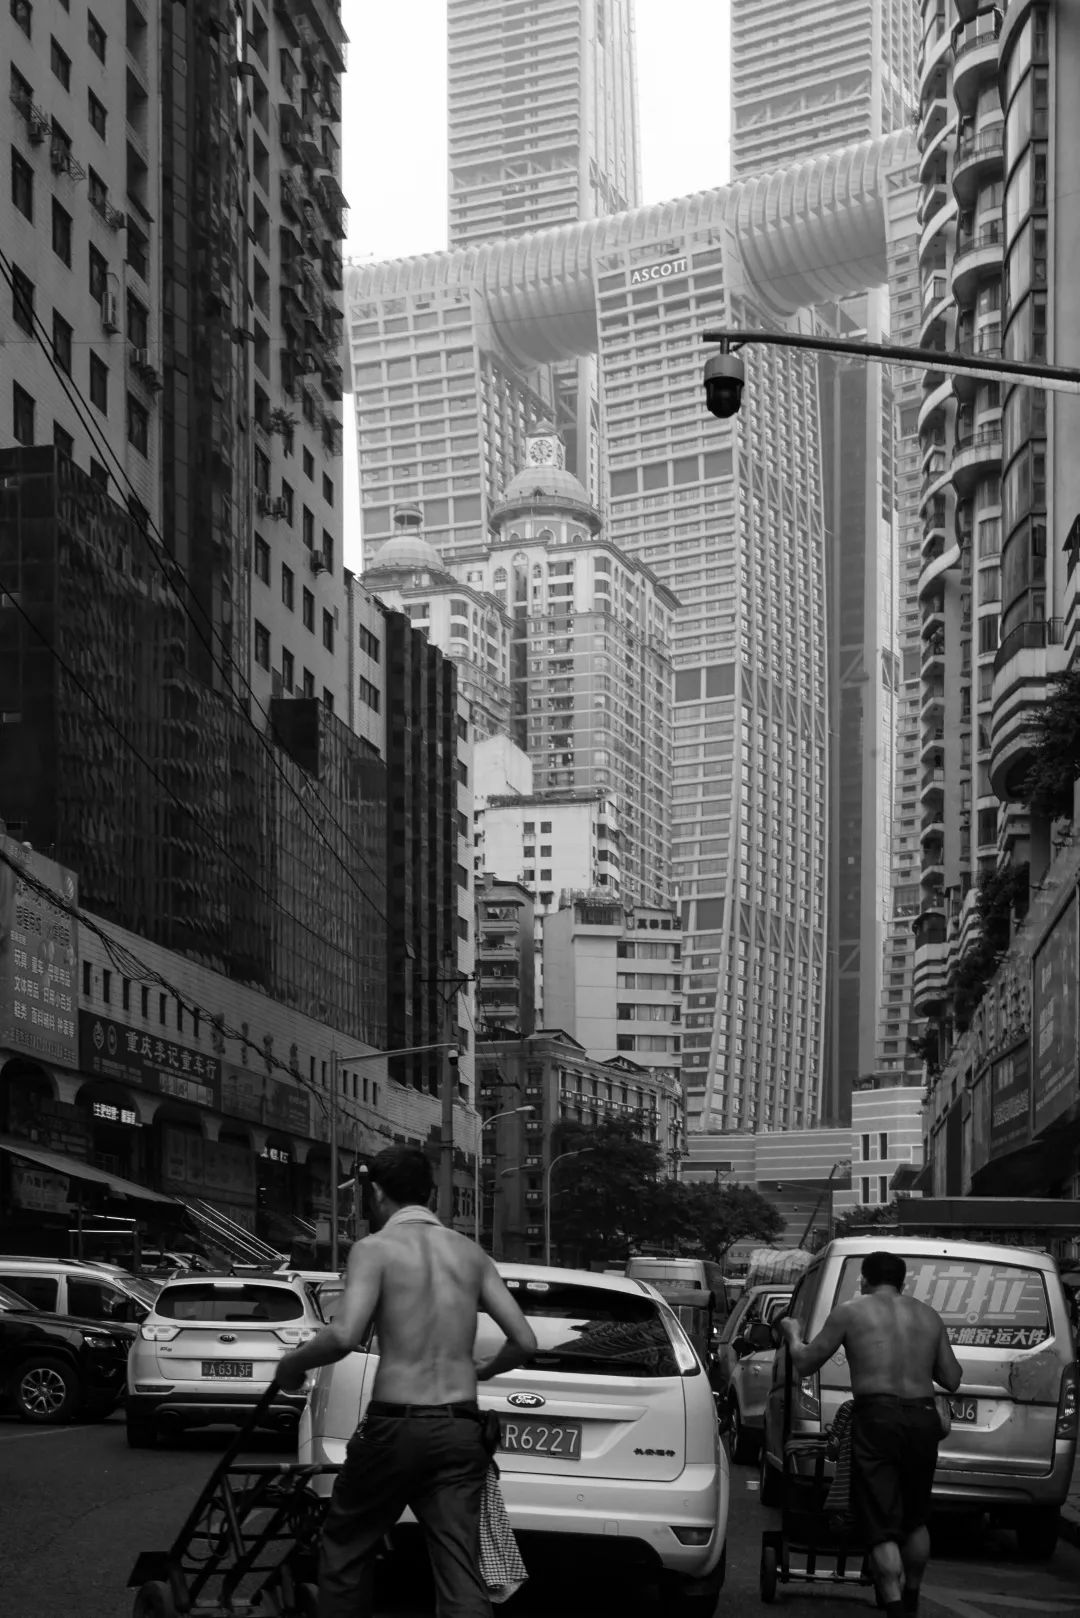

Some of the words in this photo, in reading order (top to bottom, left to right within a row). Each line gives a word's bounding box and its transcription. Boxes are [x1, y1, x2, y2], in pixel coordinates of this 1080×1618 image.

[632, 259, 687, 284] ASCOTT
[14, 976, 39, 999] 文体用品
[125, 1030, 217, 1080] 重庆李记童车行
[903, 1264, 1029, 1320] 拉拉
